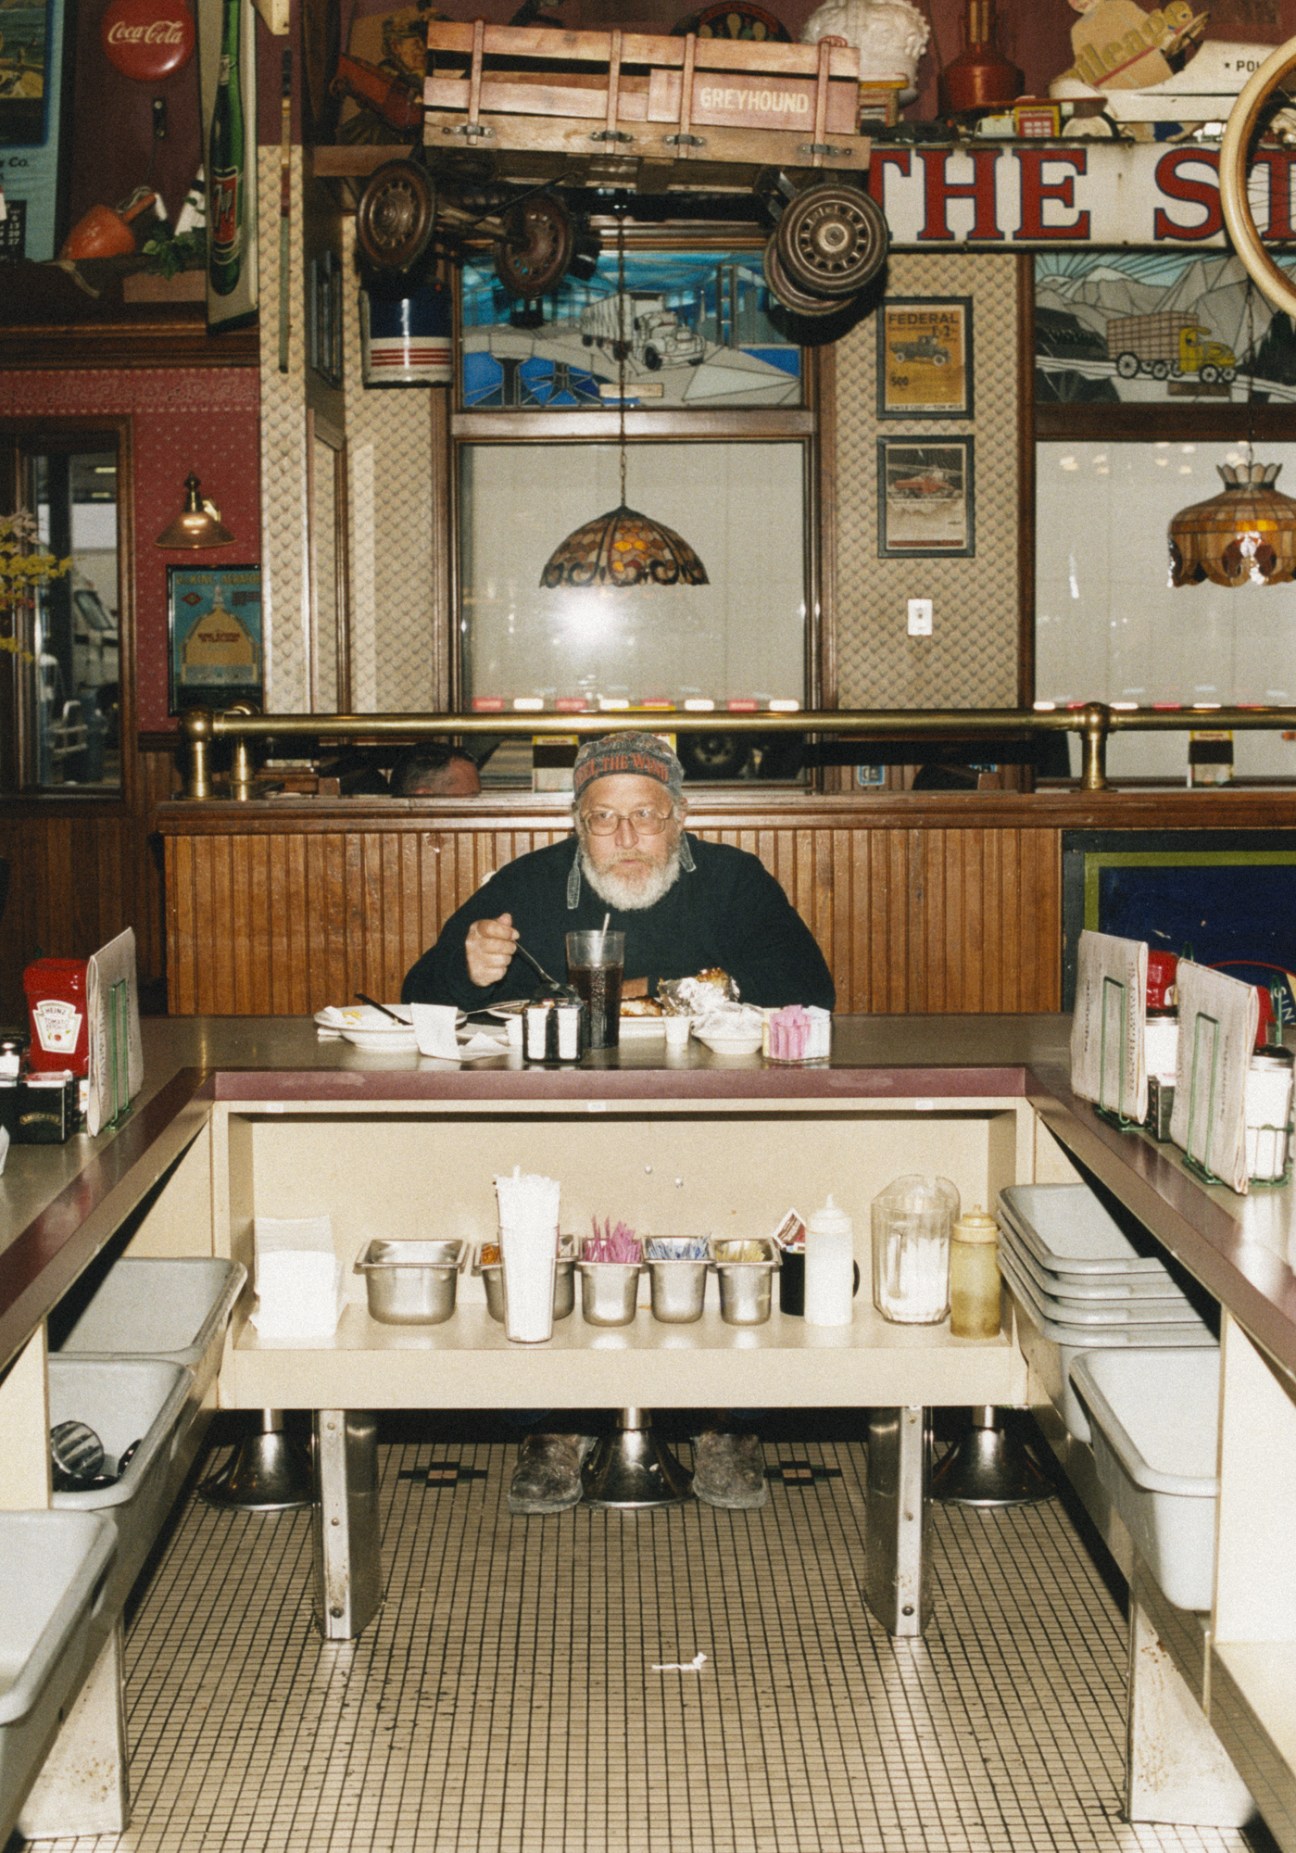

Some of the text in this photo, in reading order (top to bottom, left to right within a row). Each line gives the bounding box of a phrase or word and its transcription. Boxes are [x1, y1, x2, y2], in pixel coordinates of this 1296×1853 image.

[107, 20, 183, 44] Coca-Cola
[700, 86, 809, 113] GREYHOUND
[868, 148, 1091, 241] THE
[888, 312, 960, 325] FEDERAL
[1274, 986, 1296, 1025] SIN
